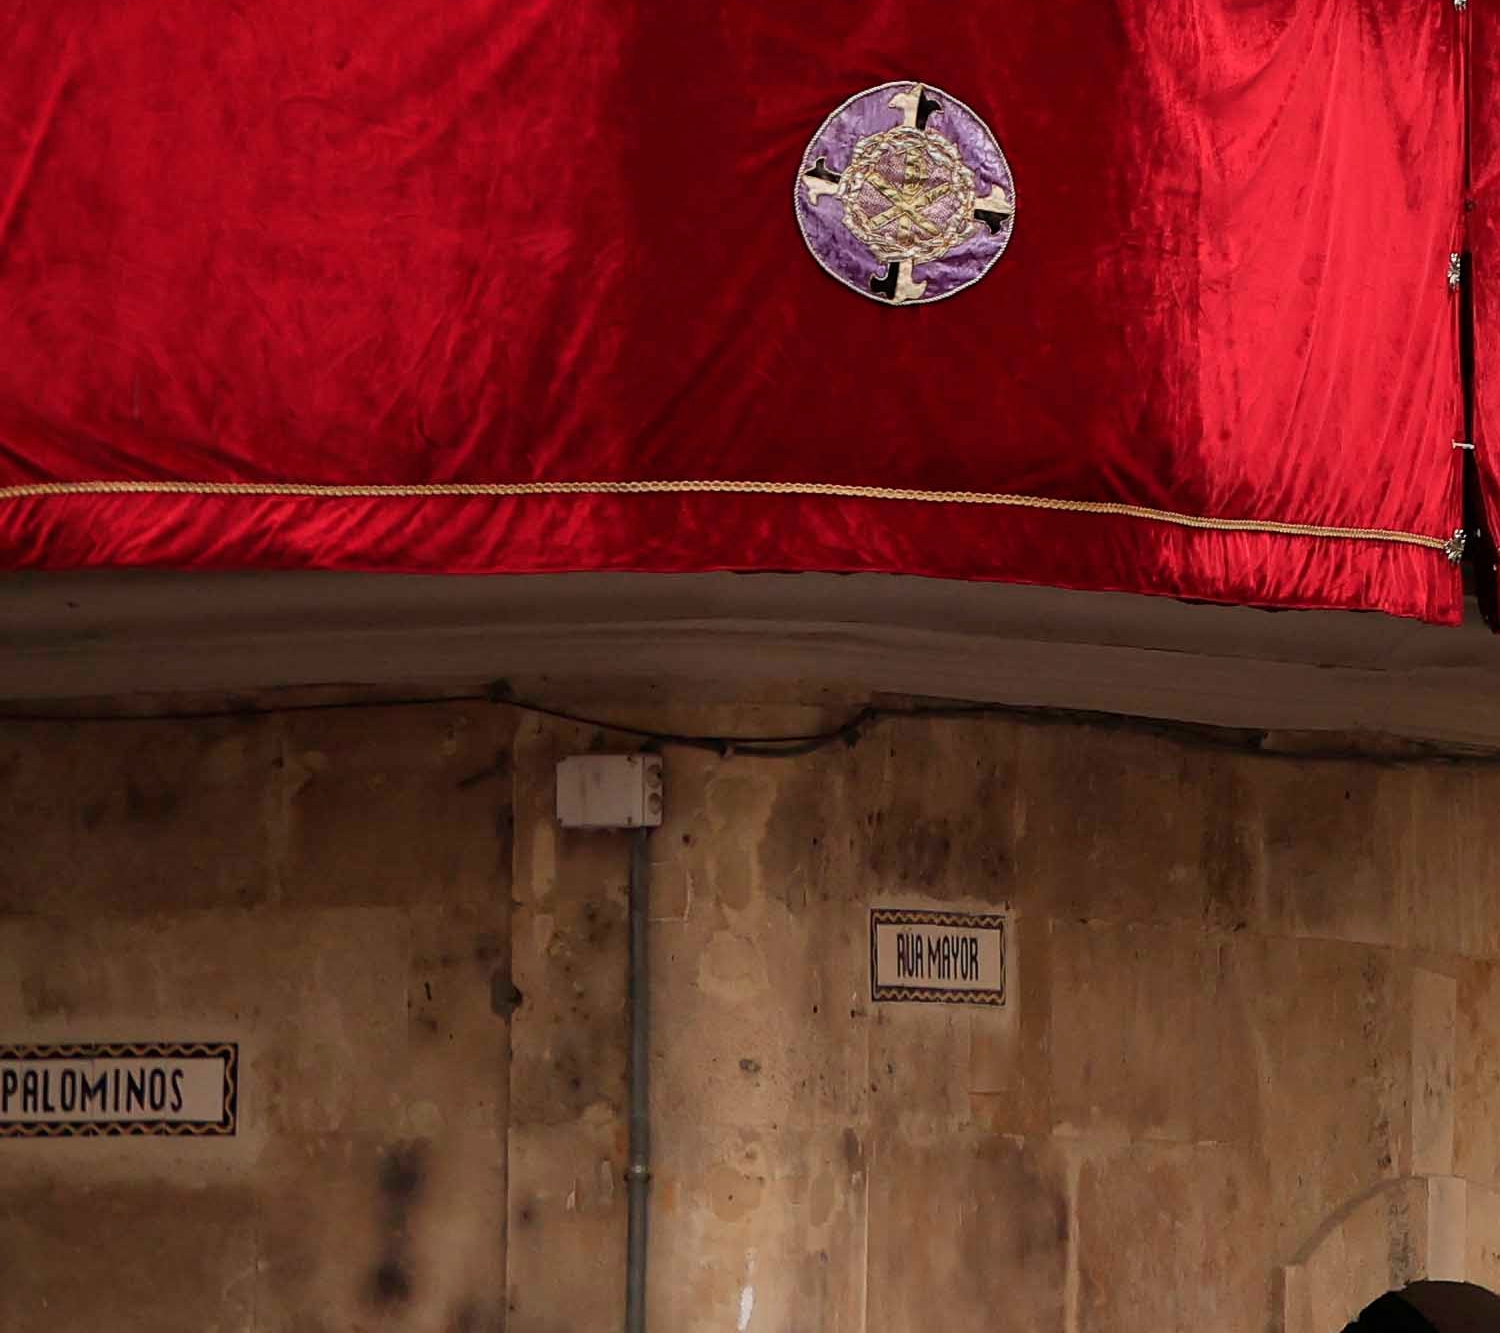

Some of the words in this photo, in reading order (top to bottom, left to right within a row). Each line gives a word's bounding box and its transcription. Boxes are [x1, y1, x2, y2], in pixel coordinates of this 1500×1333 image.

[897, 933, 924, 979] RUA
[927, 935, 979, 981] MAYOR
[2, 1067, 183, 1113] PALOMINOS
